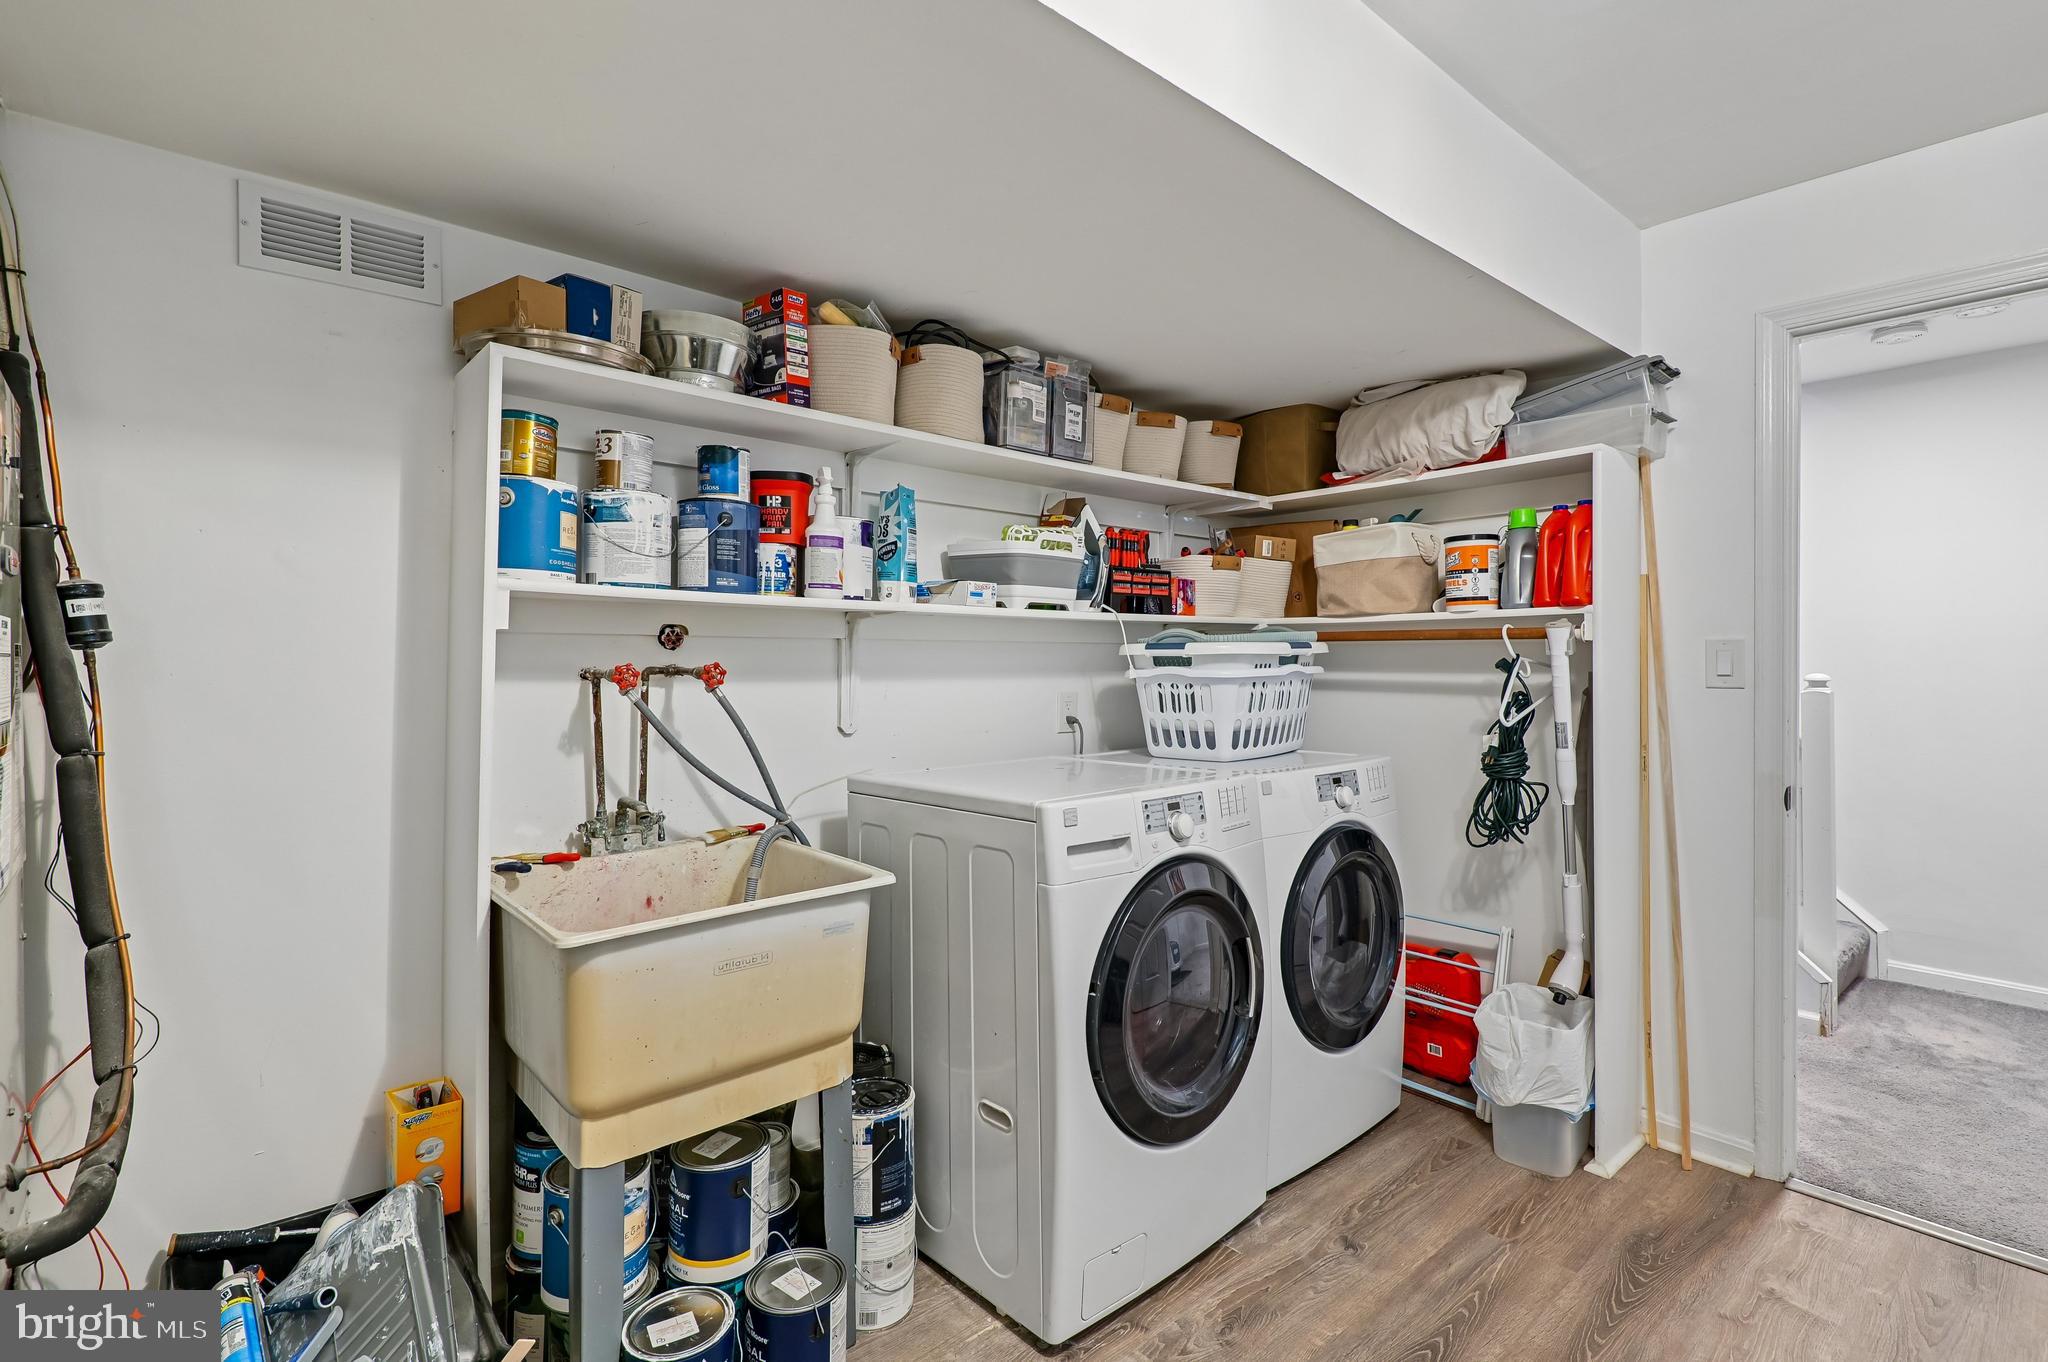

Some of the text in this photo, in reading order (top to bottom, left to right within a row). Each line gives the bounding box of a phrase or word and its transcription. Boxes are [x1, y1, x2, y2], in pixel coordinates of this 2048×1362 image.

[745, 305, 763, 320] Hefty
[762, 514, 787, 522] PAINT
[403, 1112, 432, 1126] Swiffer
